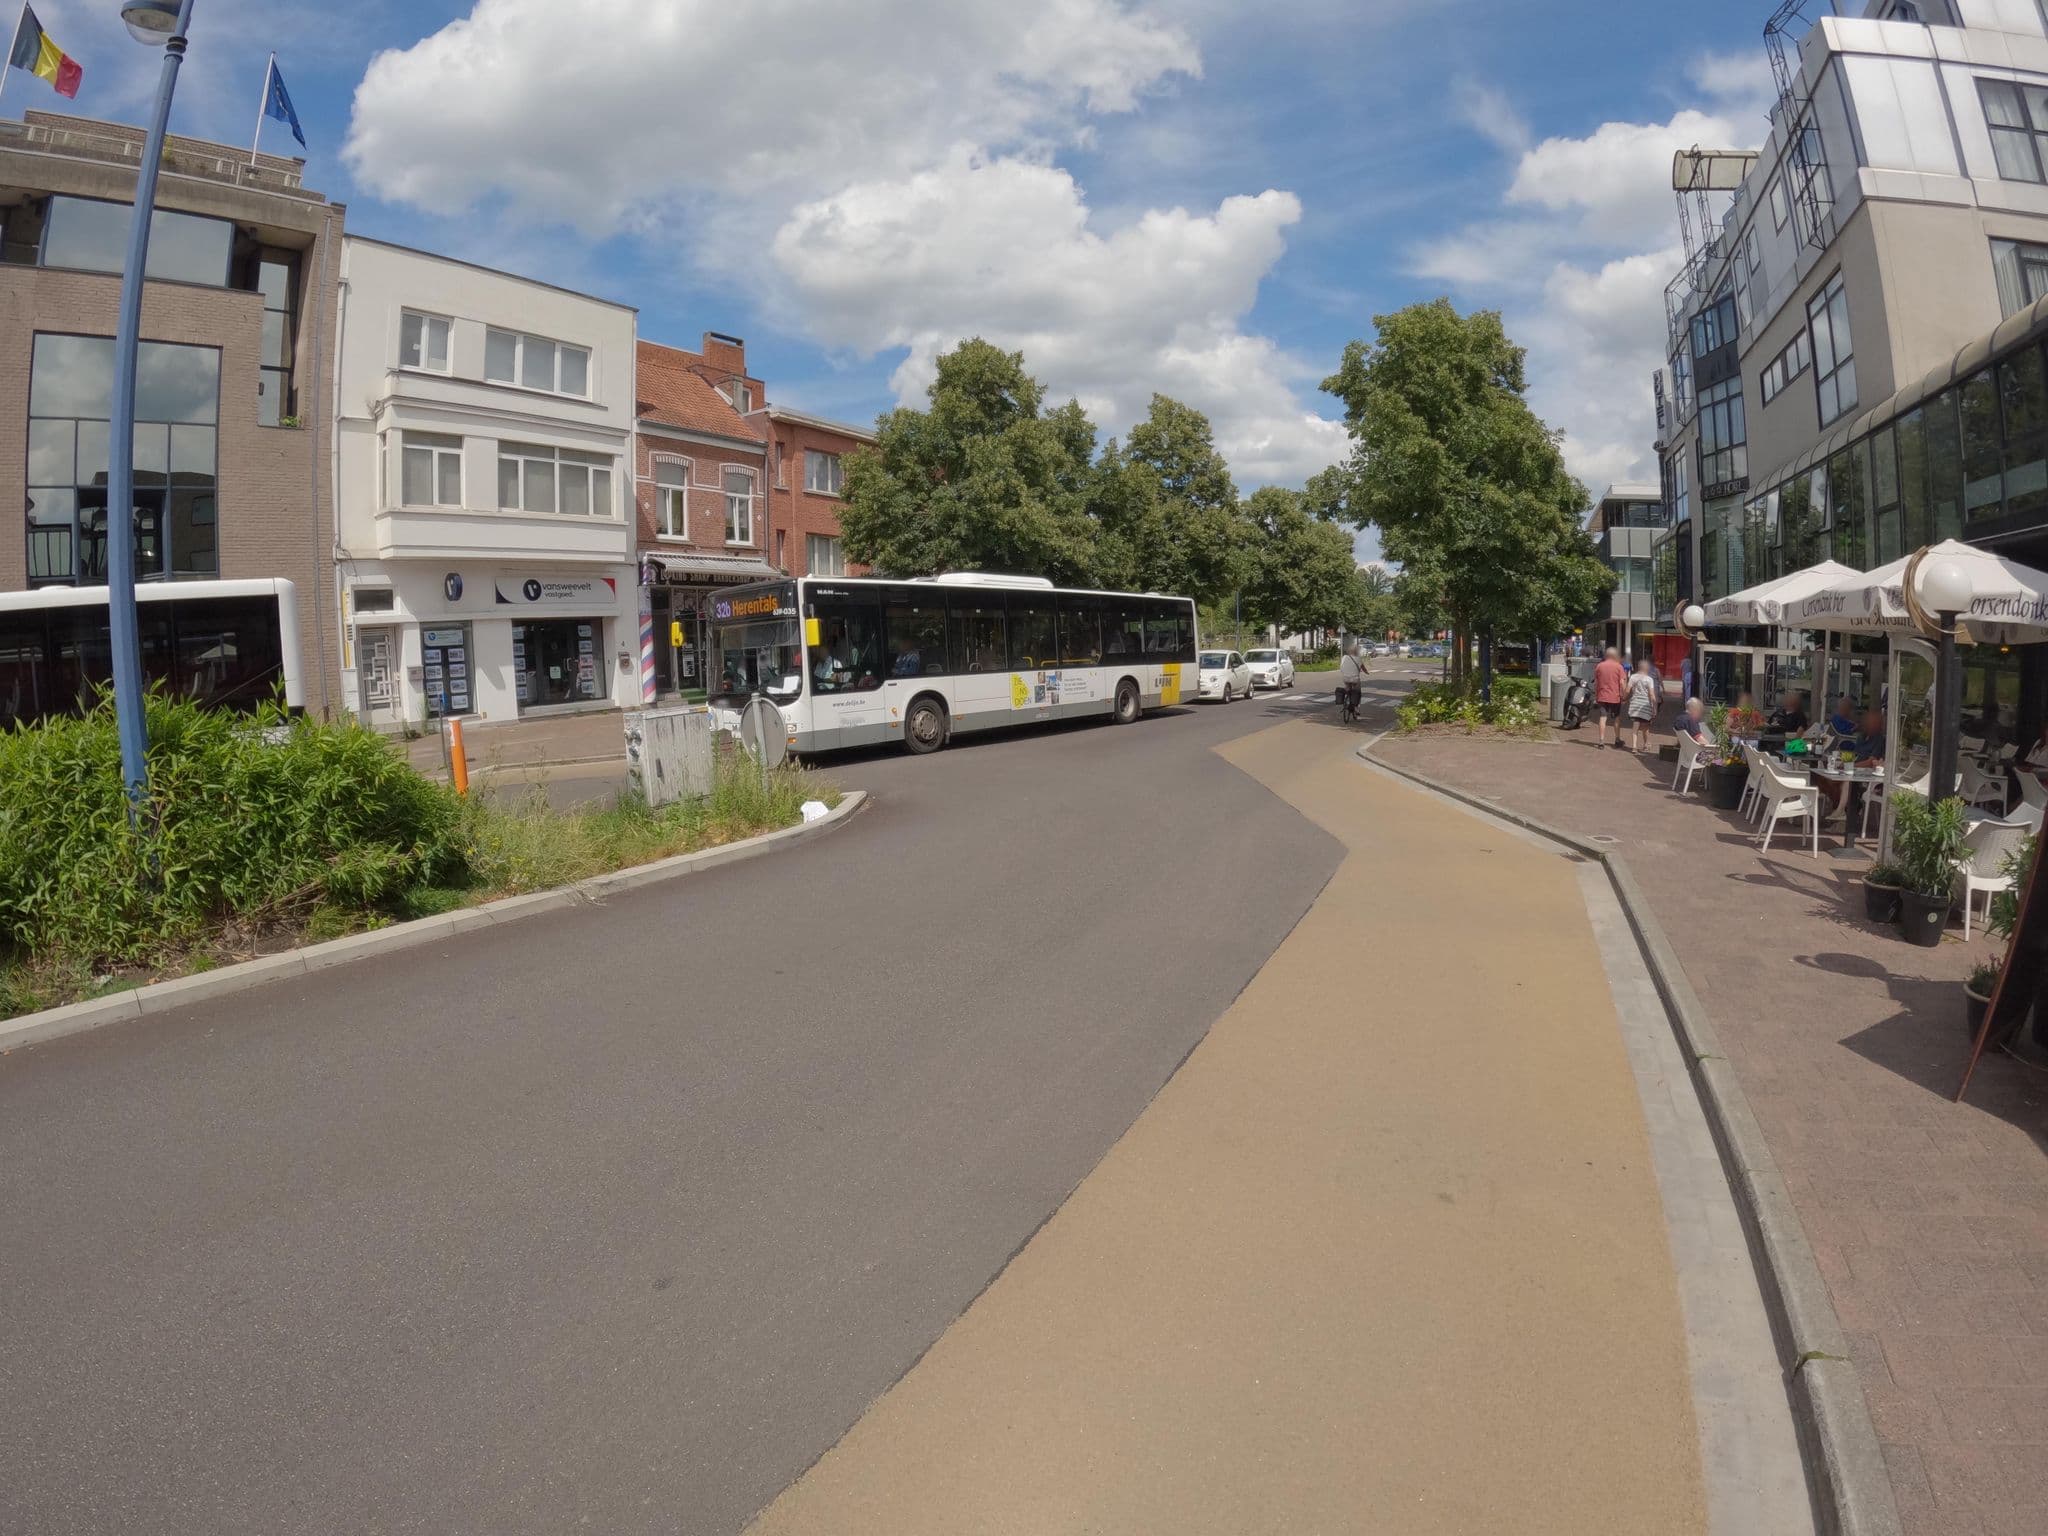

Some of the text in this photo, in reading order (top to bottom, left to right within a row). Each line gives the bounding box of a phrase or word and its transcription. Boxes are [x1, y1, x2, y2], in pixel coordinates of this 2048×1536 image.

[542, 582, 591, 591] vansweevelt
[716, 594, 778, 618] 32b Herentals
[1970, 590, 2048, 621] orsendonk
